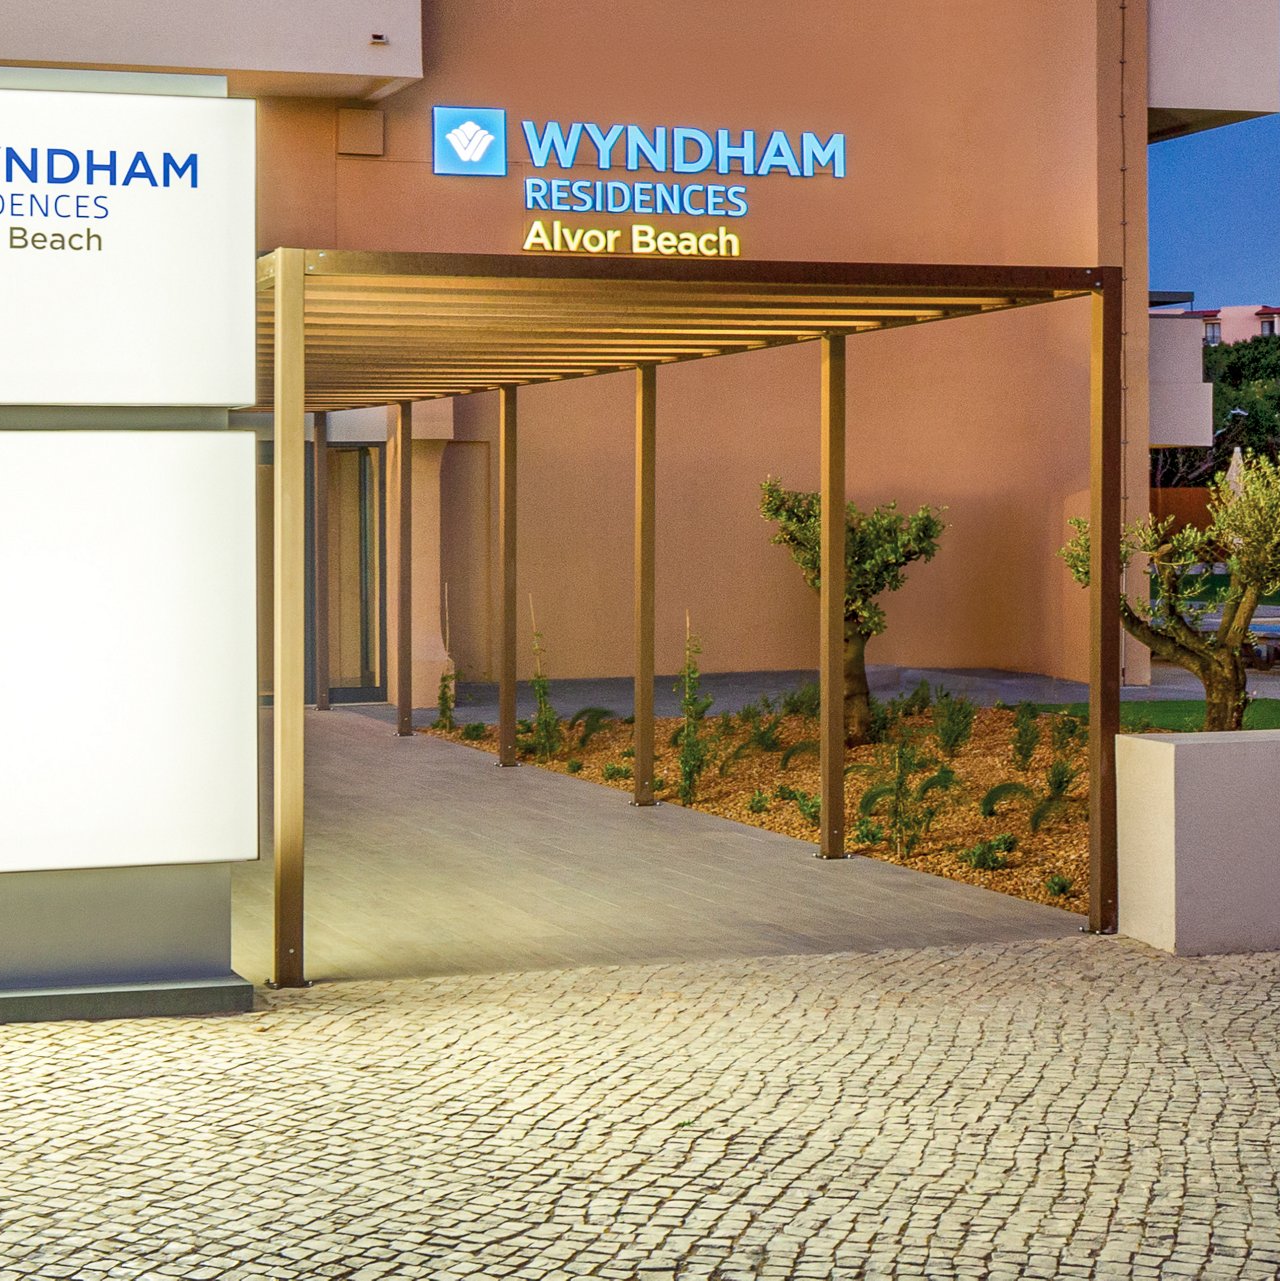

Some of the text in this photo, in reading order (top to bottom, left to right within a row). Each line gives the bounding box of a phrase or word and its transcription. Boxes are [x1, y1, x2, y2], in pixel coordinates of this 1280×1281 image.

[522, 120, 846, 178] WYNDHAM
[524, 178, 749, 217] RESIDENCES
[9, 226, 103, 252] Beach
[523, 220, 741, 257] Alvor Beach
